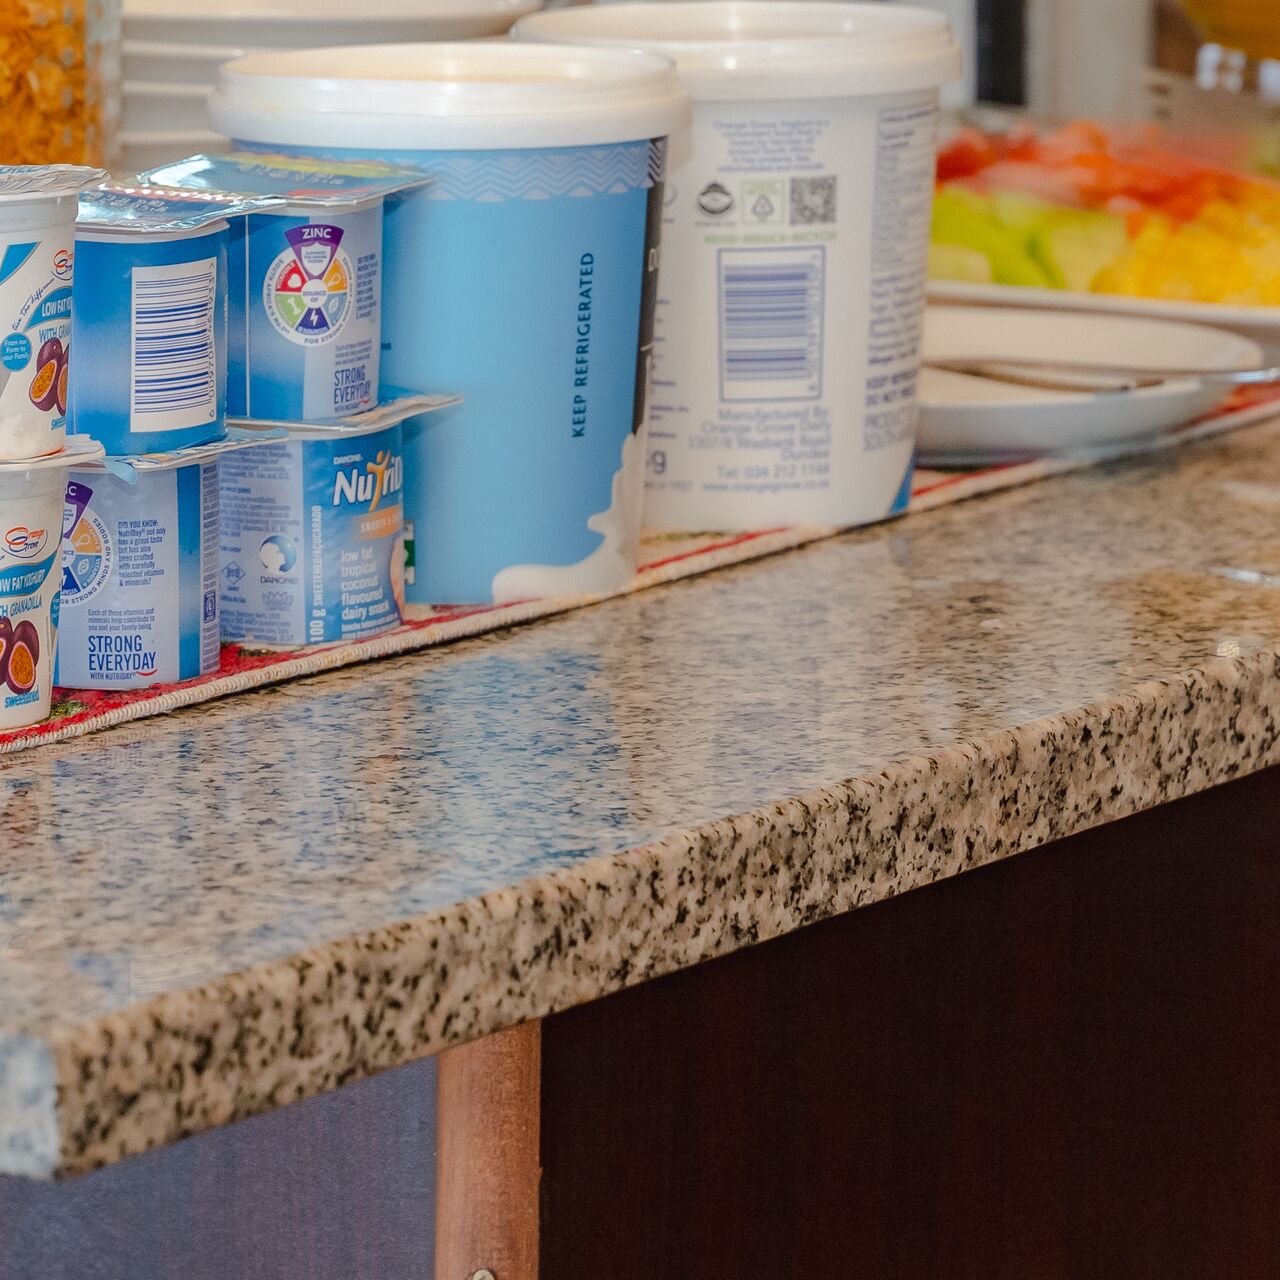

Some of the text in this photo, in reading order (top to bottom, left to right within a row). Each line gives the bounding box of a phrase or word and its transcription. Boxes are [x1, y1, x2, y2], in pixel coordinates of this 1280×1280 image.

[302, 228, 332, 239] ZINC
[42, 303, 57, 317] LOW
[39, 329, 57, 343] WITH
[572, 252, 595, 438] KEEP REFRIGERATED
[334, 365, 366, 386] STRONG
[334, 381, 371, 404] EVERYDAY
[341, 546, 373, 561] low fat
[341, 561, 376, 577] tropical
[11, 575, 23, 590] FAT
[341, 575, 378, 591] coconut
[341, 587, 383, 606] flavoured
[9, 596, 43, 617] GRANADILLA
[312, 609, 327, 617] g
[342, 599, 389, 620] dairy snack
[310, 621, 324, 641] 100
[88, 634, 142, 653] STRONG
[89, 651, 156, 671] EVERYDAY
[90, 672, 104, 680] WITH
[4, 688, 40, 708] sweetened
